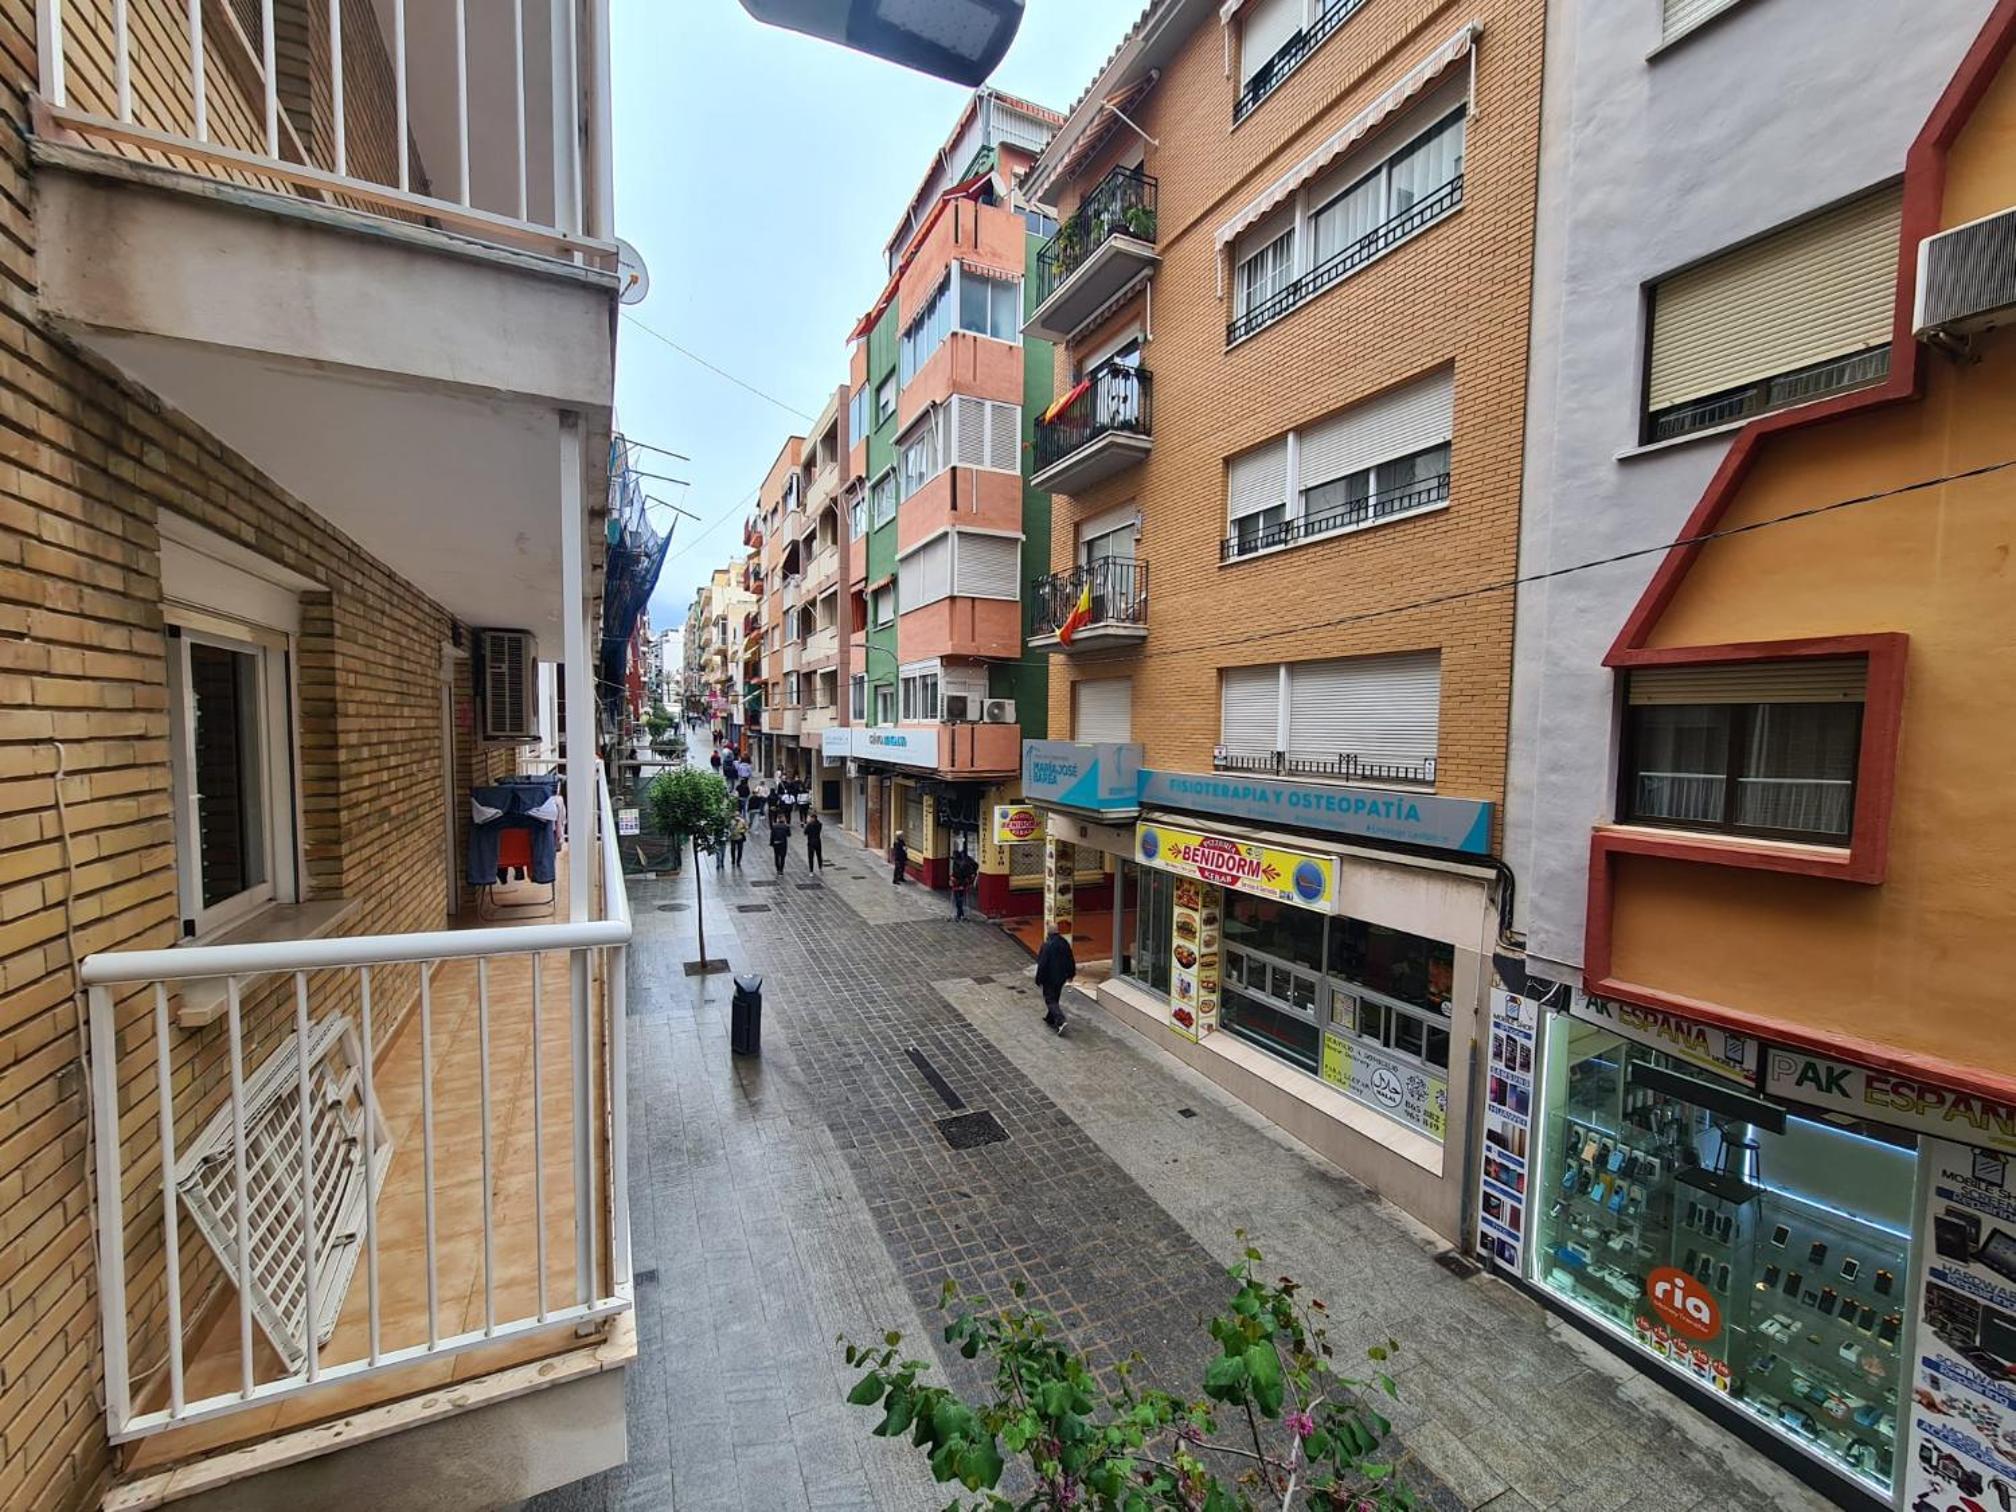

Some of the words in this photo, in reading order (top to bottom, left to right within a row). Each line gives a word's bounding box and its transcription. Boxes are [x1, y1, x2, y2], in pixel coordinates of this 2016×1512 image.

[1169, 778, 1269, 804] FISIOTERAPIA
[1273, 790, 1283, 804] Y
[1288, 791, 1421, 822] OSTEOPATÍA
[1182, 845, 1261, 879] BENIDORM
[1205, 871, 1232, 884] KEBAB
[1771, 1054, 1853, 1099] PAK
[1376, 1090, 1396, 1103] HALAL
[1942, 1169, 1995, 1193] MOBILE
[1655, 1278, 1710, 1324] ria
